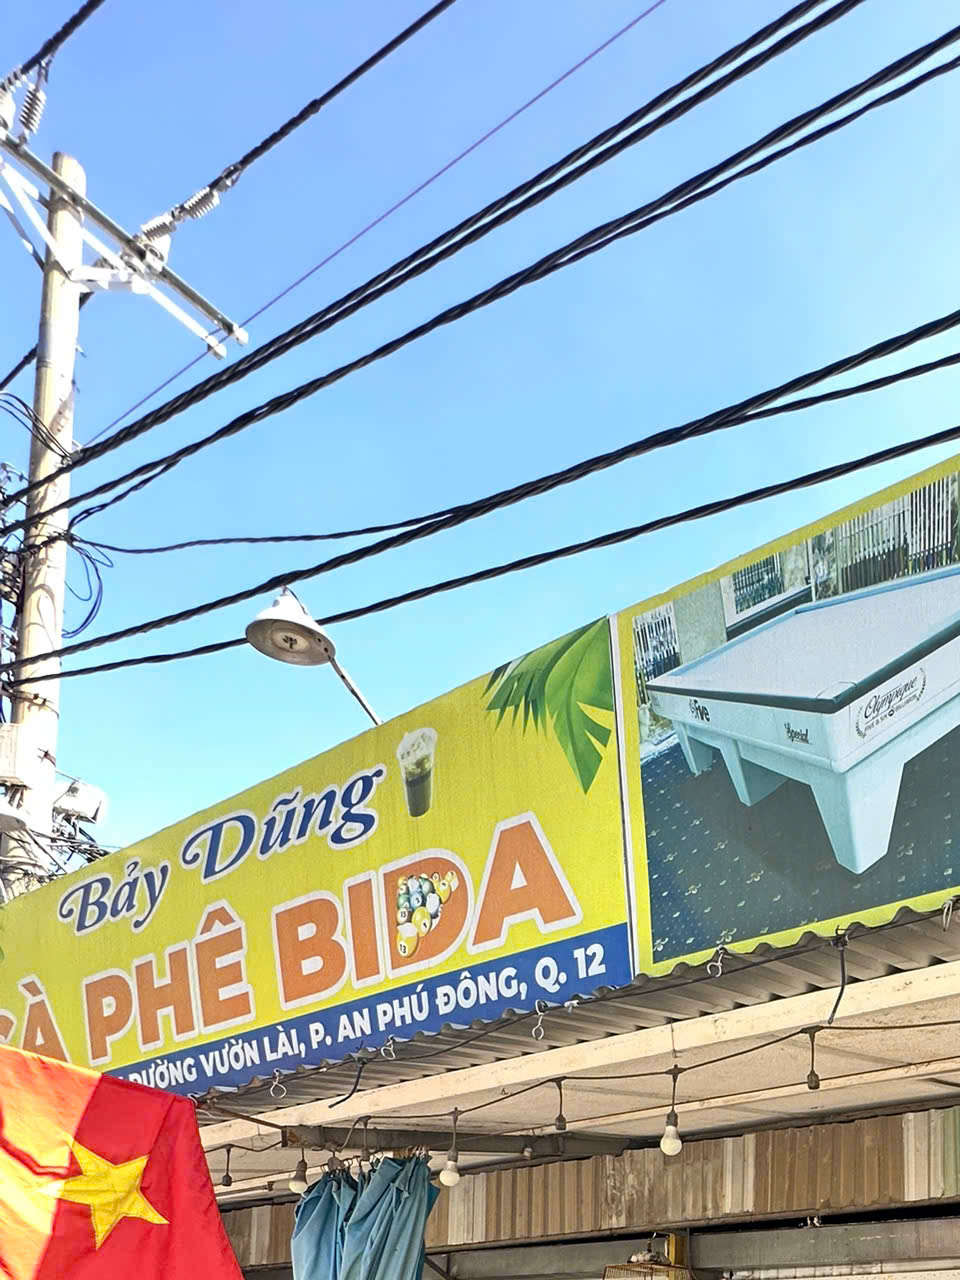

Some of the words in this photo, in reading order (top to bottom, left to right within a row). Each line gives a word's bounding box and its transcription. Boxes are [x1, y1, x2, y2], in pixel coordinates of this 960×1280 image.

[58, 857, 171, 937] Bảy
[181, 762, 387, 886] Dũng
[80, 902, 254, 1067] PHÊ
[273, 811, 583, 1009] BIDA
[199, 1037, 260, 1078] VƯỜN
[263, 1027, 306, 1060] LÀI,
[309, 1021, 332, 1050] P.
[337, 1008, 372, 1043] AN
[376, 984, 430, 1032] PHÚ
[435, 966, 528, 1016] ĐÔNG,
[534, 956, 567, 994] Q.
[573, 942, 606, 979] 12
